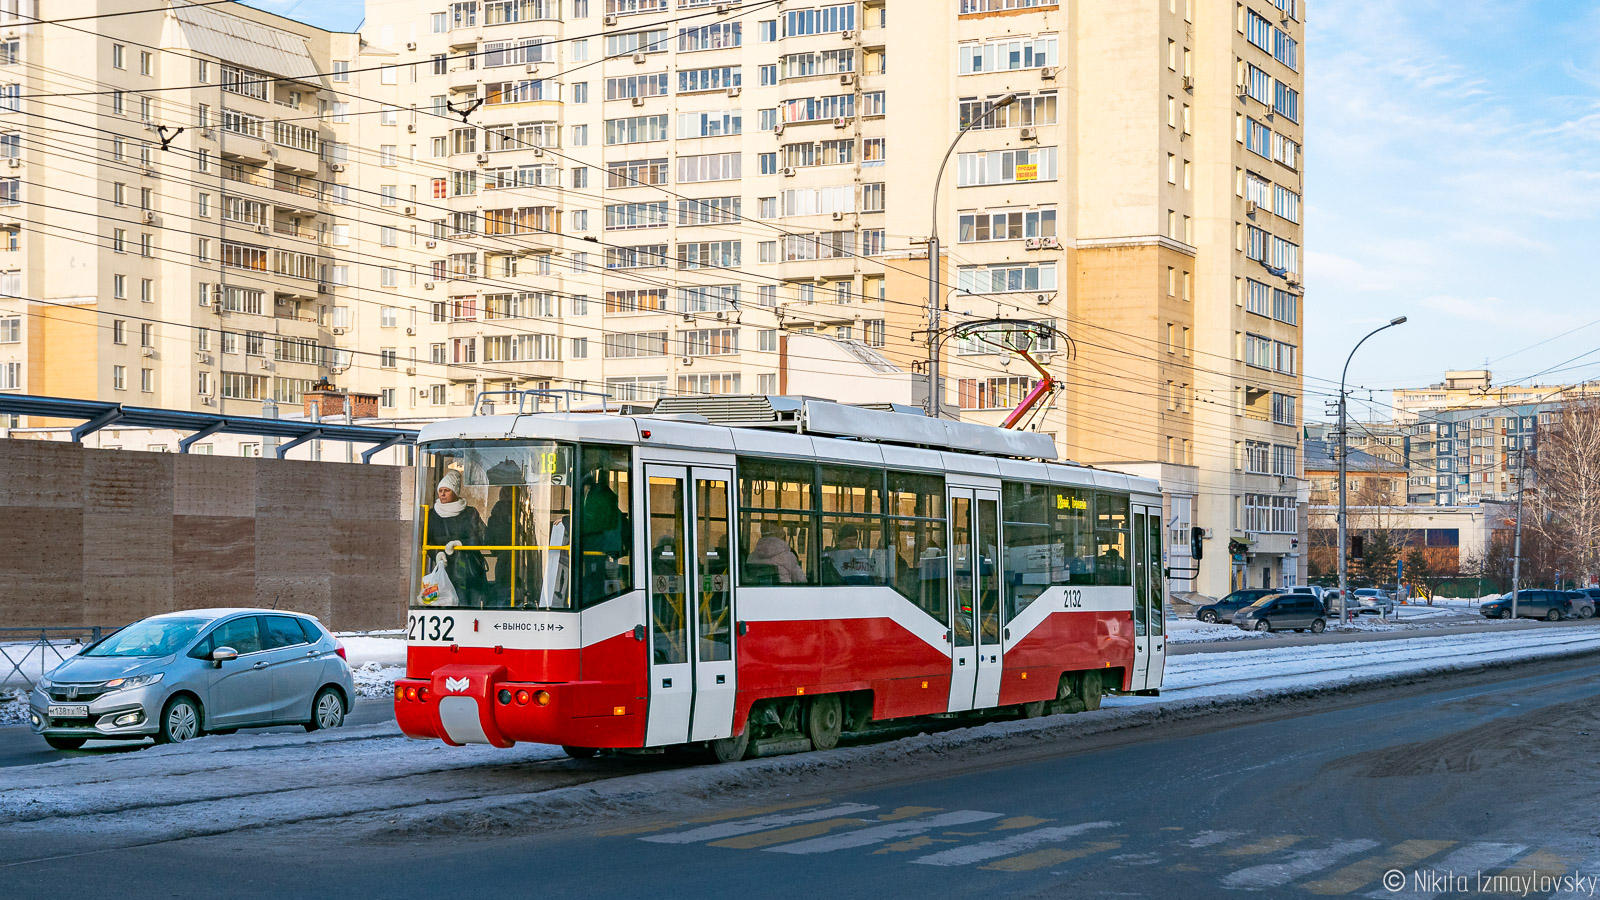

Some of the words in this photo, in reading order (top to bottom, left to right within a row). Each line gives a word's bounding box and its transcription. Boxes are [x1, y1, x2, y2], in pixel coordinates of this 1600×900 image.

[541, 452, 557, 474] 18
[1063, 589, 1082, 608] 2132
[408, 615, 455, 642] 2132
[502, 622, 532, 631] ВЫНОС
[533, 623, 546, 632] 1,5
